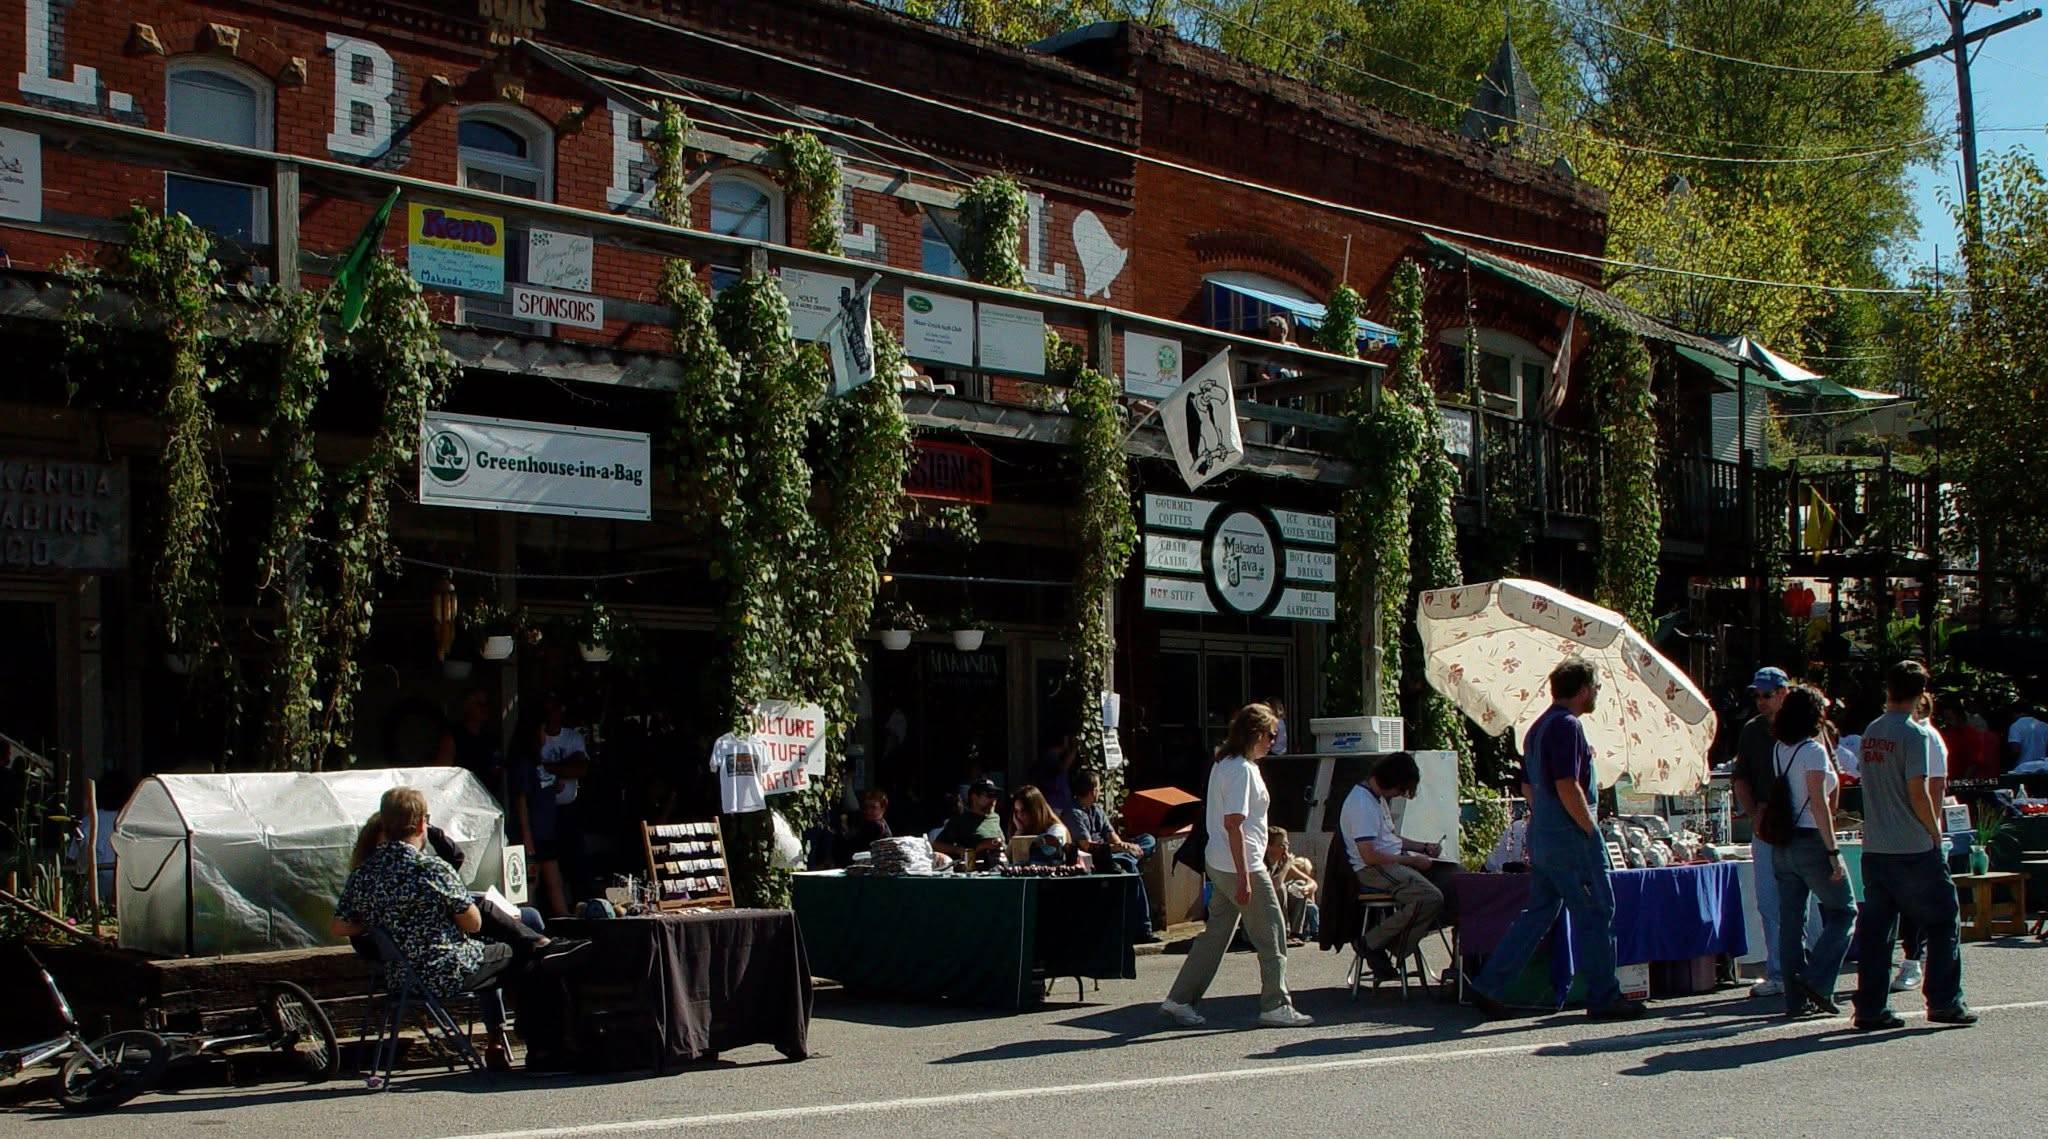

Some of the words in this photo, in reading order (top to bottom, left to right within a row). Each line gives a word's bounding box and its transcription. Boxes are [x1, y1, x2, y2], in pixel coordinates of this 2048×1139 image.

[421, 269, 463, 286] Makanda
[519, 292, 596, 323] SPONSORS
[476, 450, 643, 486] Greenhouse-in-a-Bag
[0, 464, 113, 497] KANDA
[1155, 498, 1193, 511] GOURMET
[1158, 513, 1193, 526] COFFEES
[1286, 513, 1298, 524] ICE
[1308, 516, 1332, 529] CREAM
[1160, 540, 1186, 553] CHAIR
[1223, 536, 1265, 556] Makanda
[1158, 555, 1188, 568] CANING
[1290, 551, 1304, 562] HOT
[1314, 554, 1332, 565] COLD
[1227, 554, 1258, 588] Java
[1297, 566, 1324, 578] DRINKS
[1171, 590, 1195, 601] STUFF
[1301, 591, 1318, 603] DELI
[1286, 605, 1330, 617] SANDWICHES
[763, 741, 808, 763] TUFF
